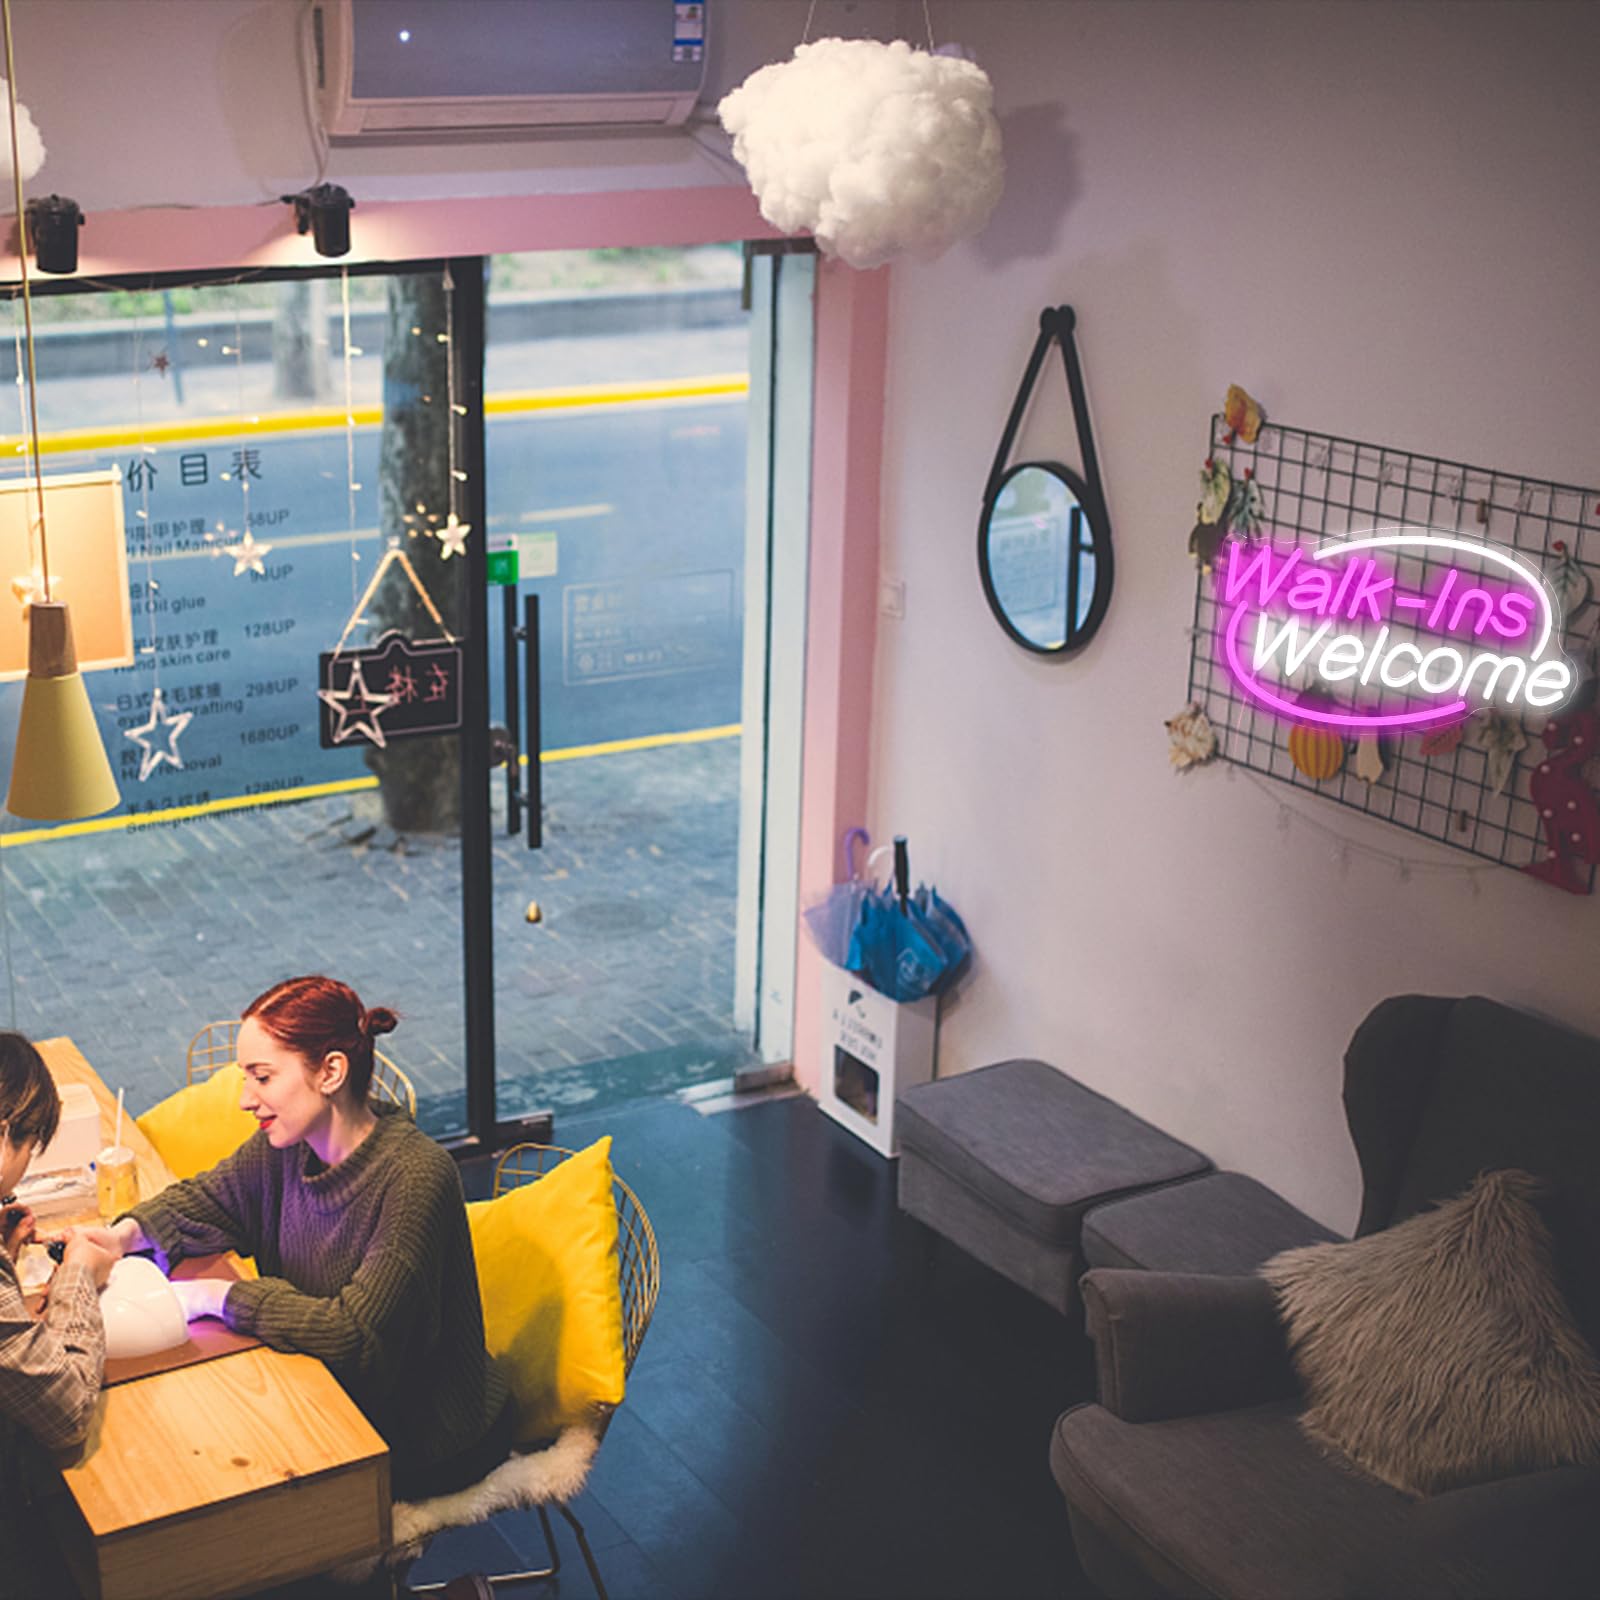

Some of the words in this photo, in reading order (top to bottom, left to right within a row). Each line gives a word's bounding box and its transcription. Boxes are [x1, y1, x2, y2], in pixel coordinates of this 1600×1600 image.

[127, 449, 262, 492] 价目表
[171, 595, 206, 615] glue
[1224, 541, 1535, 638] Walk-Ins
[244, 618, 296, 639] 128UP
[113, 656, 156, 675] nd
[160, 652, 193, 669] skin
[196, 648, 231, 664] care
[1252, 610, 1572, 708] Welcome
